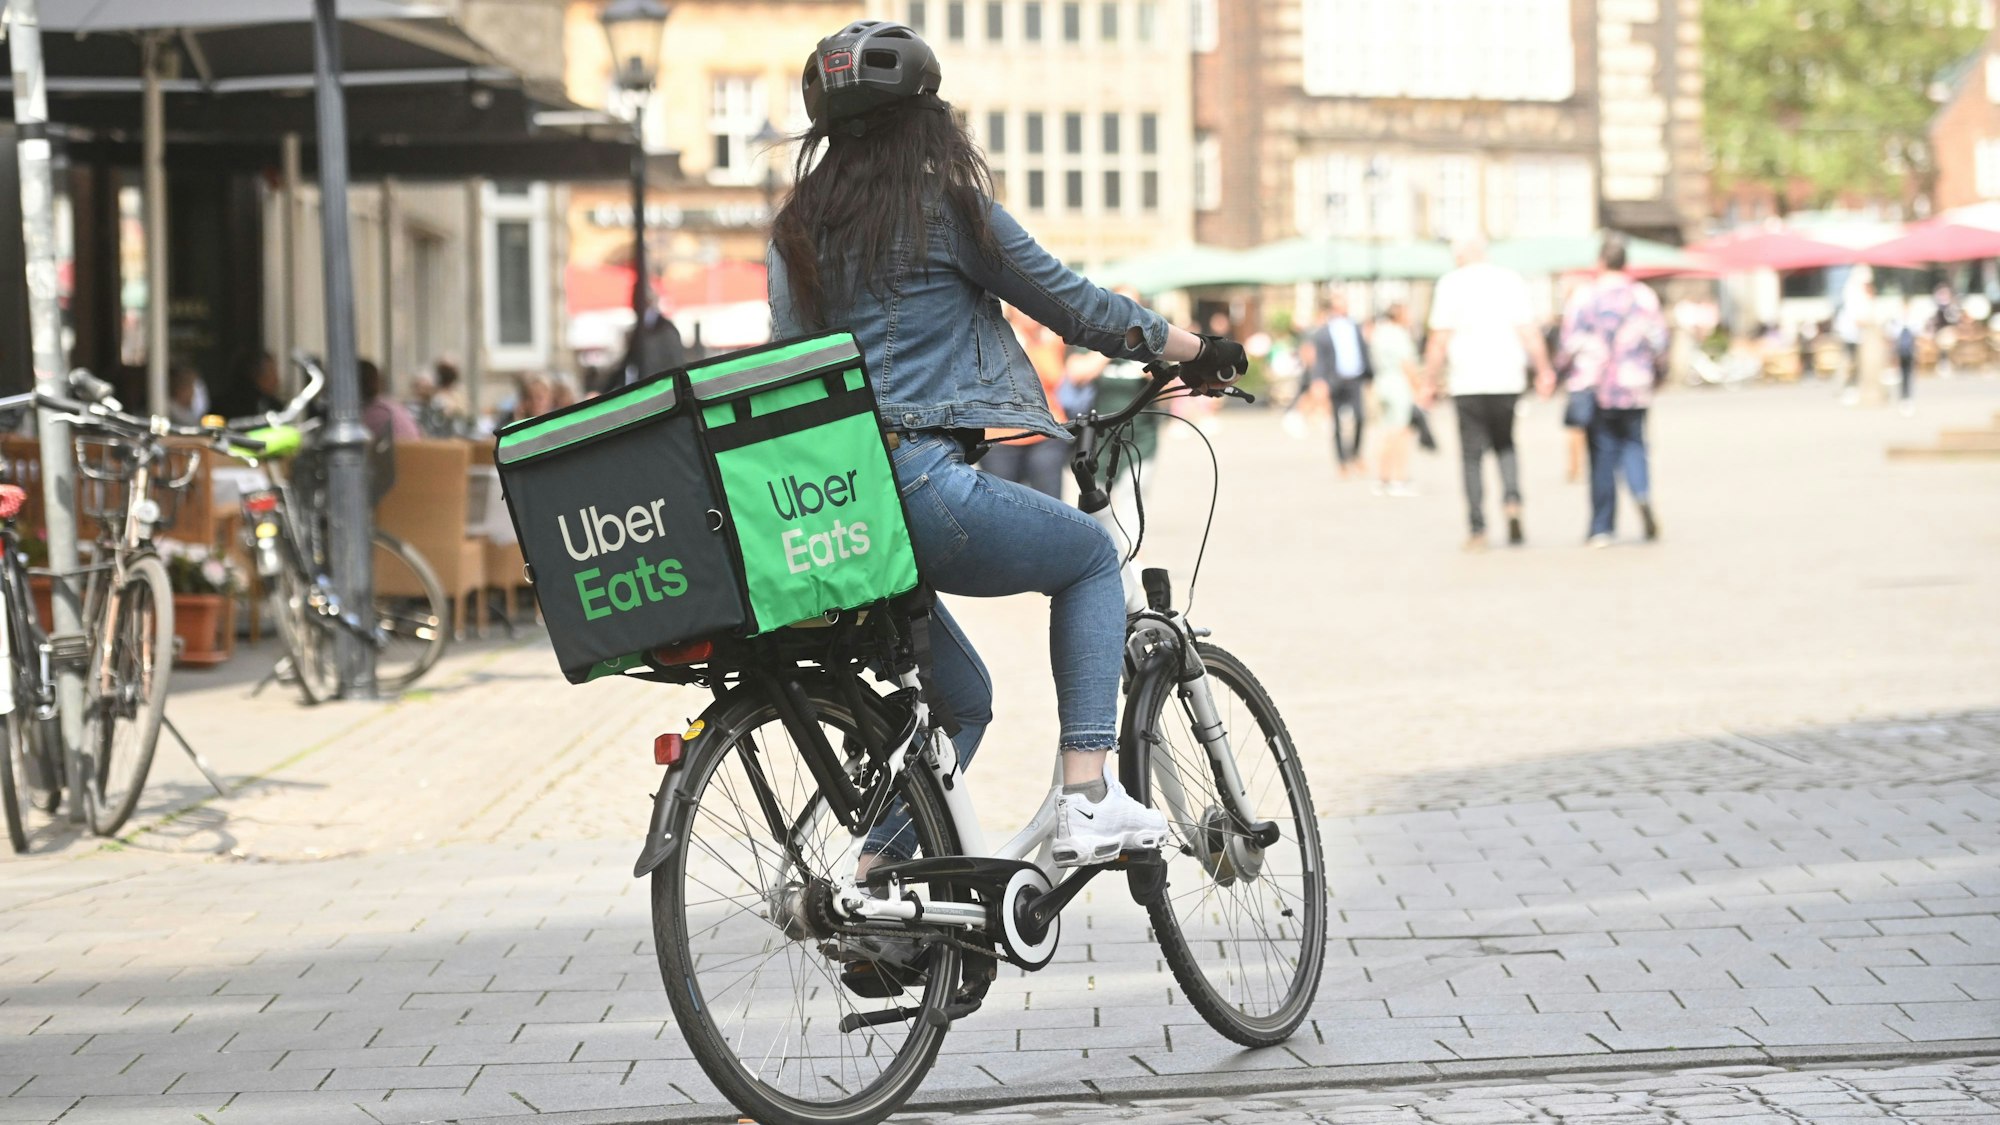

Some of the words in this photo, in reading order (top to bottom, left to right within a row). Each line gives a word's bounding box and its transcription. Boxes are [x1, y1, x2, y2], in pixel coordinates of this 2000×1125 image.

[767, 468, 858, 521] Uber
[557, 498, 666, 561] Uber
[781, 519, 871, 575] Eats
[574, 556, 688, 621] Eats
